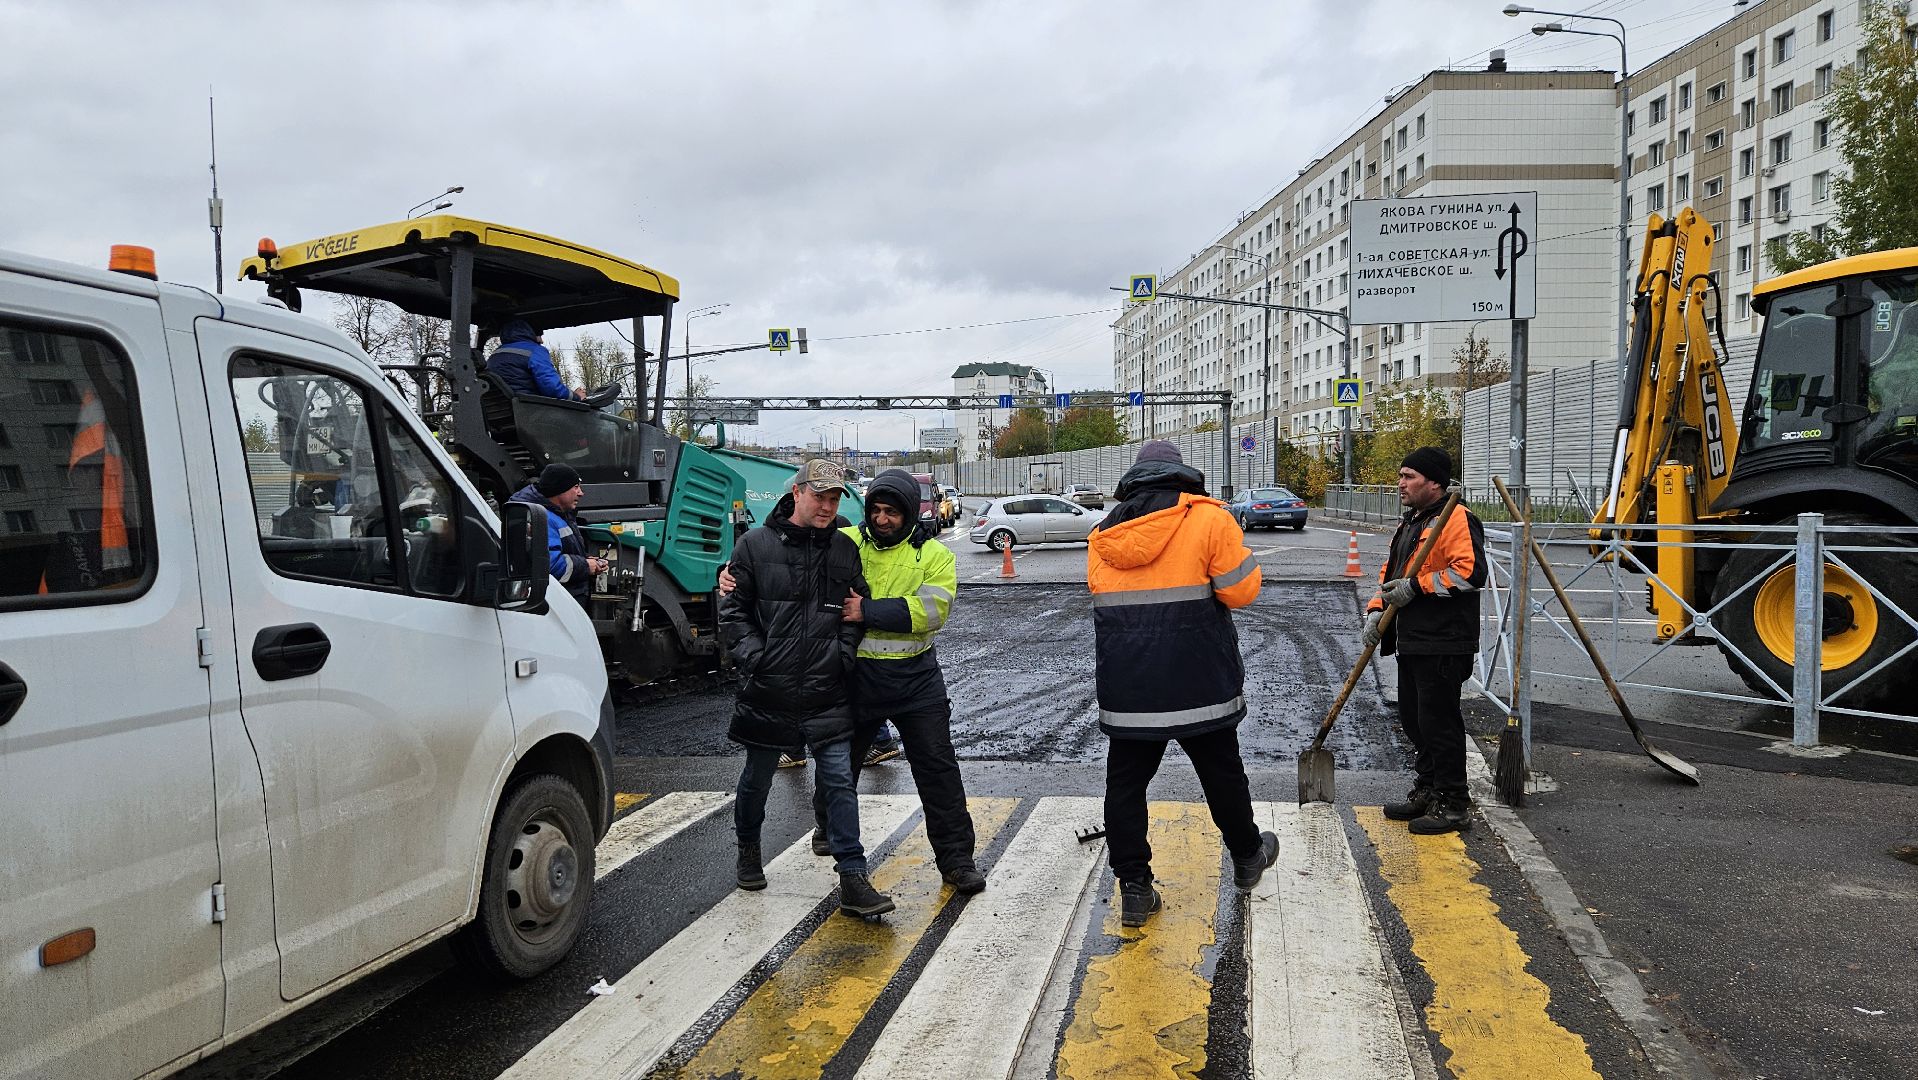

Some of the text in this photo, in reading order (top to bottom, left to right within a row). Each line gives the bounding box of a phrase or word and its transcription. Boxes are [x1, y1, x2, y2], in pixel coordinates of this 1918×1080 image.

[1380, 203, 1506, 218] ЯКОВА ГУНИНА ул.
[1380, 220, 1497, 235] ДМИТРОВСКОЕ ш.
[1356, 247, 1491, 263] 1-ая СОВЕТСКАЯ ул.
[1357, 265, 1473, 279] ЛИХАЧЕВСКОЕ ш.
[1357, 286, 1416, 298] разворот
[1877, 301, 1891, 330] JCB
[1701, 374, 1725, 477] JCB
